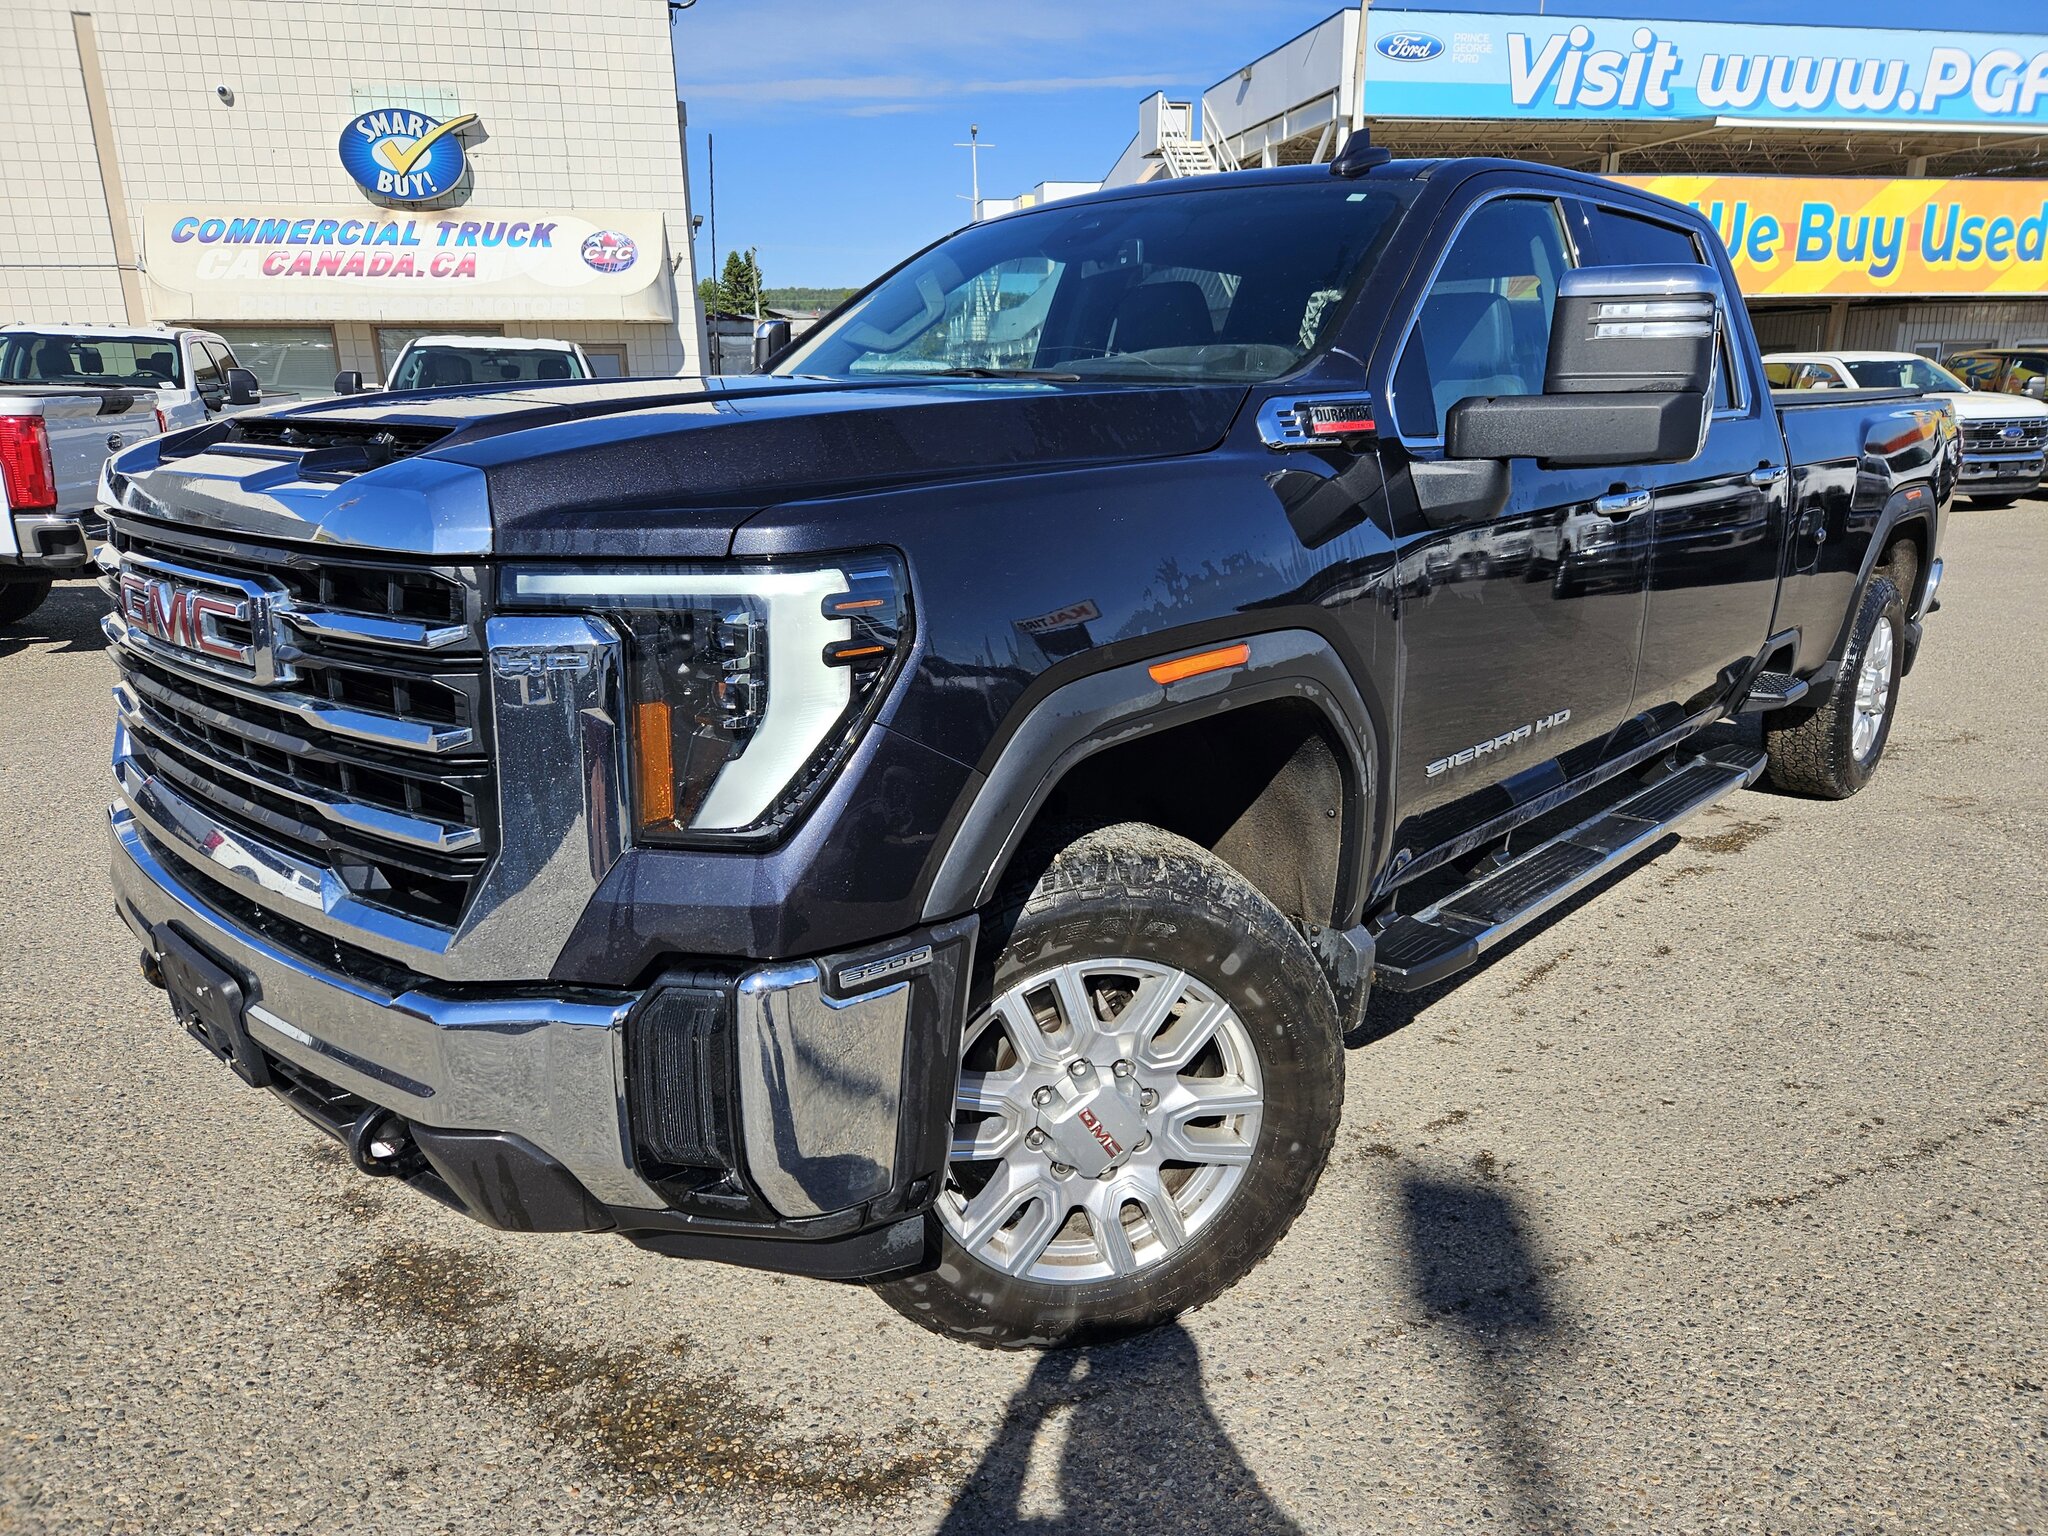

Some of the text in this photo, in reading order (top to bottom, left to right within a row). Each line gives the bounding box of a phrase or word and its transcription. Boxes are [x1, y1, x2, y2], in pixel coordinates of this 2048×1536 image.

[1387, 34, 1432, 58] Ford
[1452, 44, 1493, 54] GEORGE
[1453, 33, 1490, 43] PRINCE
[1451, 54, 1479, 64] FORD
[1507, 25, 1679, 107] Visit
[356, 112, 439, 144] SMART
[377, 170, 438, 196] BUY!
[170, 216, 559, 249] COMMERCIAL TRUCK
[1795, 202, 1906, 278] Buy
[1921, 202, 2048, 264] Used
[262, 250, 477, 279] CANADA.CA
[583, 246, 634, 261] CTC
[1314, 406, 1369, 422] DURAMAX
[121, 572, 255, 664] GMC
[1424, 708, 1571, 778] SIERRA HD
[843, 949, 929, 983] 3500
[1078, 1106, 1124, 1160] GMC
